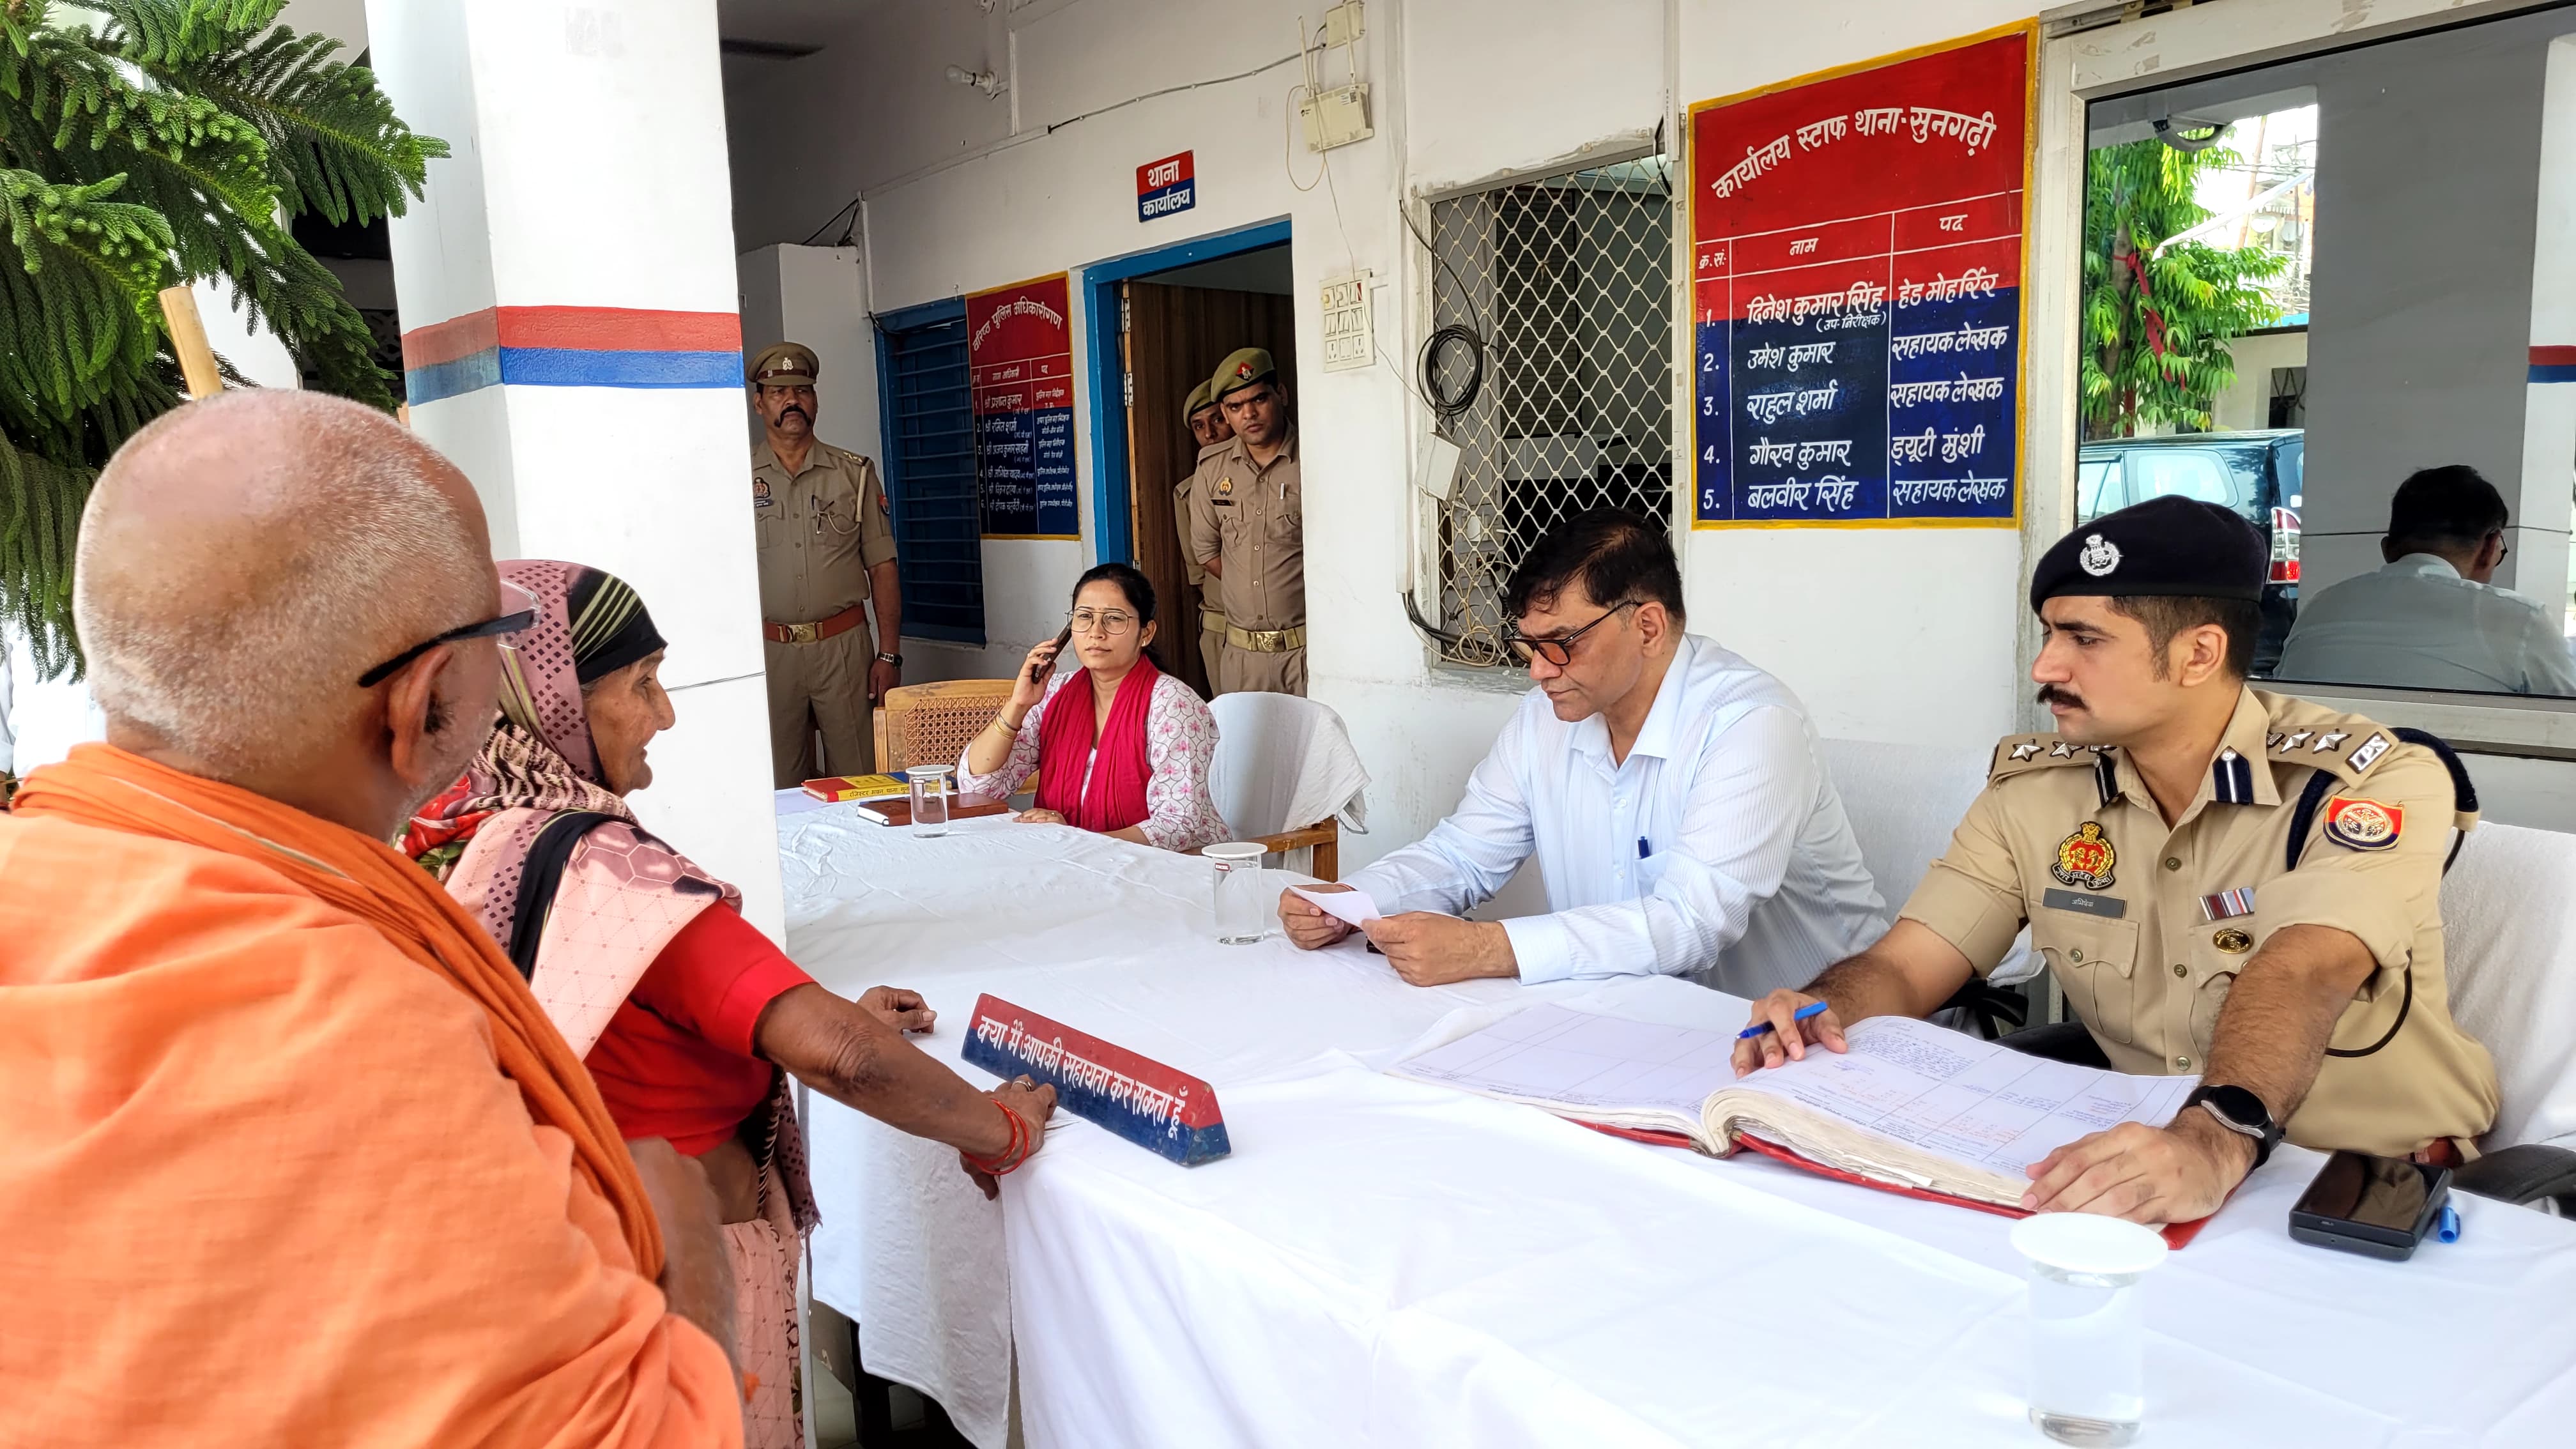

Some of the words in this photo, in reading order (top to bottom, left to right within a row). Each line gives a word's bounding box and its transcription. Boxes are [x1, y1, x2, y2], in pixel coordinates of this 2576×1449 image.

[1147, 160, 1180, 187] थाना
[1711, 135, 1790, 198] कार्यालय
[1796, 115, 1848, 151] स्टाफ
[1142, 188, 1191, 216] कार्यालय
[1939, 214, 1968, 231] पद
[1790, 238, 1819, 256] नाम
[1746, 293, 1793, 325] दिनेश
[1792, 291, 1845, 326] कुमार
[1846, 280, 1887, 314] सिंह
[1898, 278, 1925, 309] हेड
[992, 303, 1012, 329] पुलिस
[1703, 353, 1719, 372] 2.
[1747, 342, 1786, 369] उमेश
[1787, 341, 1836, 372] कुमार
[1892, 331, 1956, 361] सहायक
[1954, 321, 2009, 352] लेखक
[1703, 396, 1719, 416] 3.
[1747, 392, 1796, 425] राहुल
[1795, 379, 1839, 415] शर्मा
[1890, 381, 1952, 408] सहायक
[1951, 371, 2005, 402] लेखक
[1703, 445, 1720, 464] 4.
[1749, 436, 1797, 468] गौरव
[1797, 440, 1853, 471] कुमार
[1890, 427, 1937, 466] ड्यूटी
[1941, 424, 1986, 463] मुंशी
[1703, 489, 1720, 510] 5.
[1747, 477, 1812, 510] बलवीर
[1814, 475, 1859, 512] सिंह
[1892, 479, 1958, 506] सहायक
[1958, 470, 2008, 504] लेखक
[2349, 735, 2390, 771] IPS
[977, 1015, 1009, 1051] क्या
[1020, 1034, 1064, 1077] आपकी
[1062, 1050, 1114, 1097] सहायता
[1110, 1071, 1135, 1109] कर
[1132, 1080, 1174, 1126] सकता
[1168, 1085, 1188, 1140] हूँ
